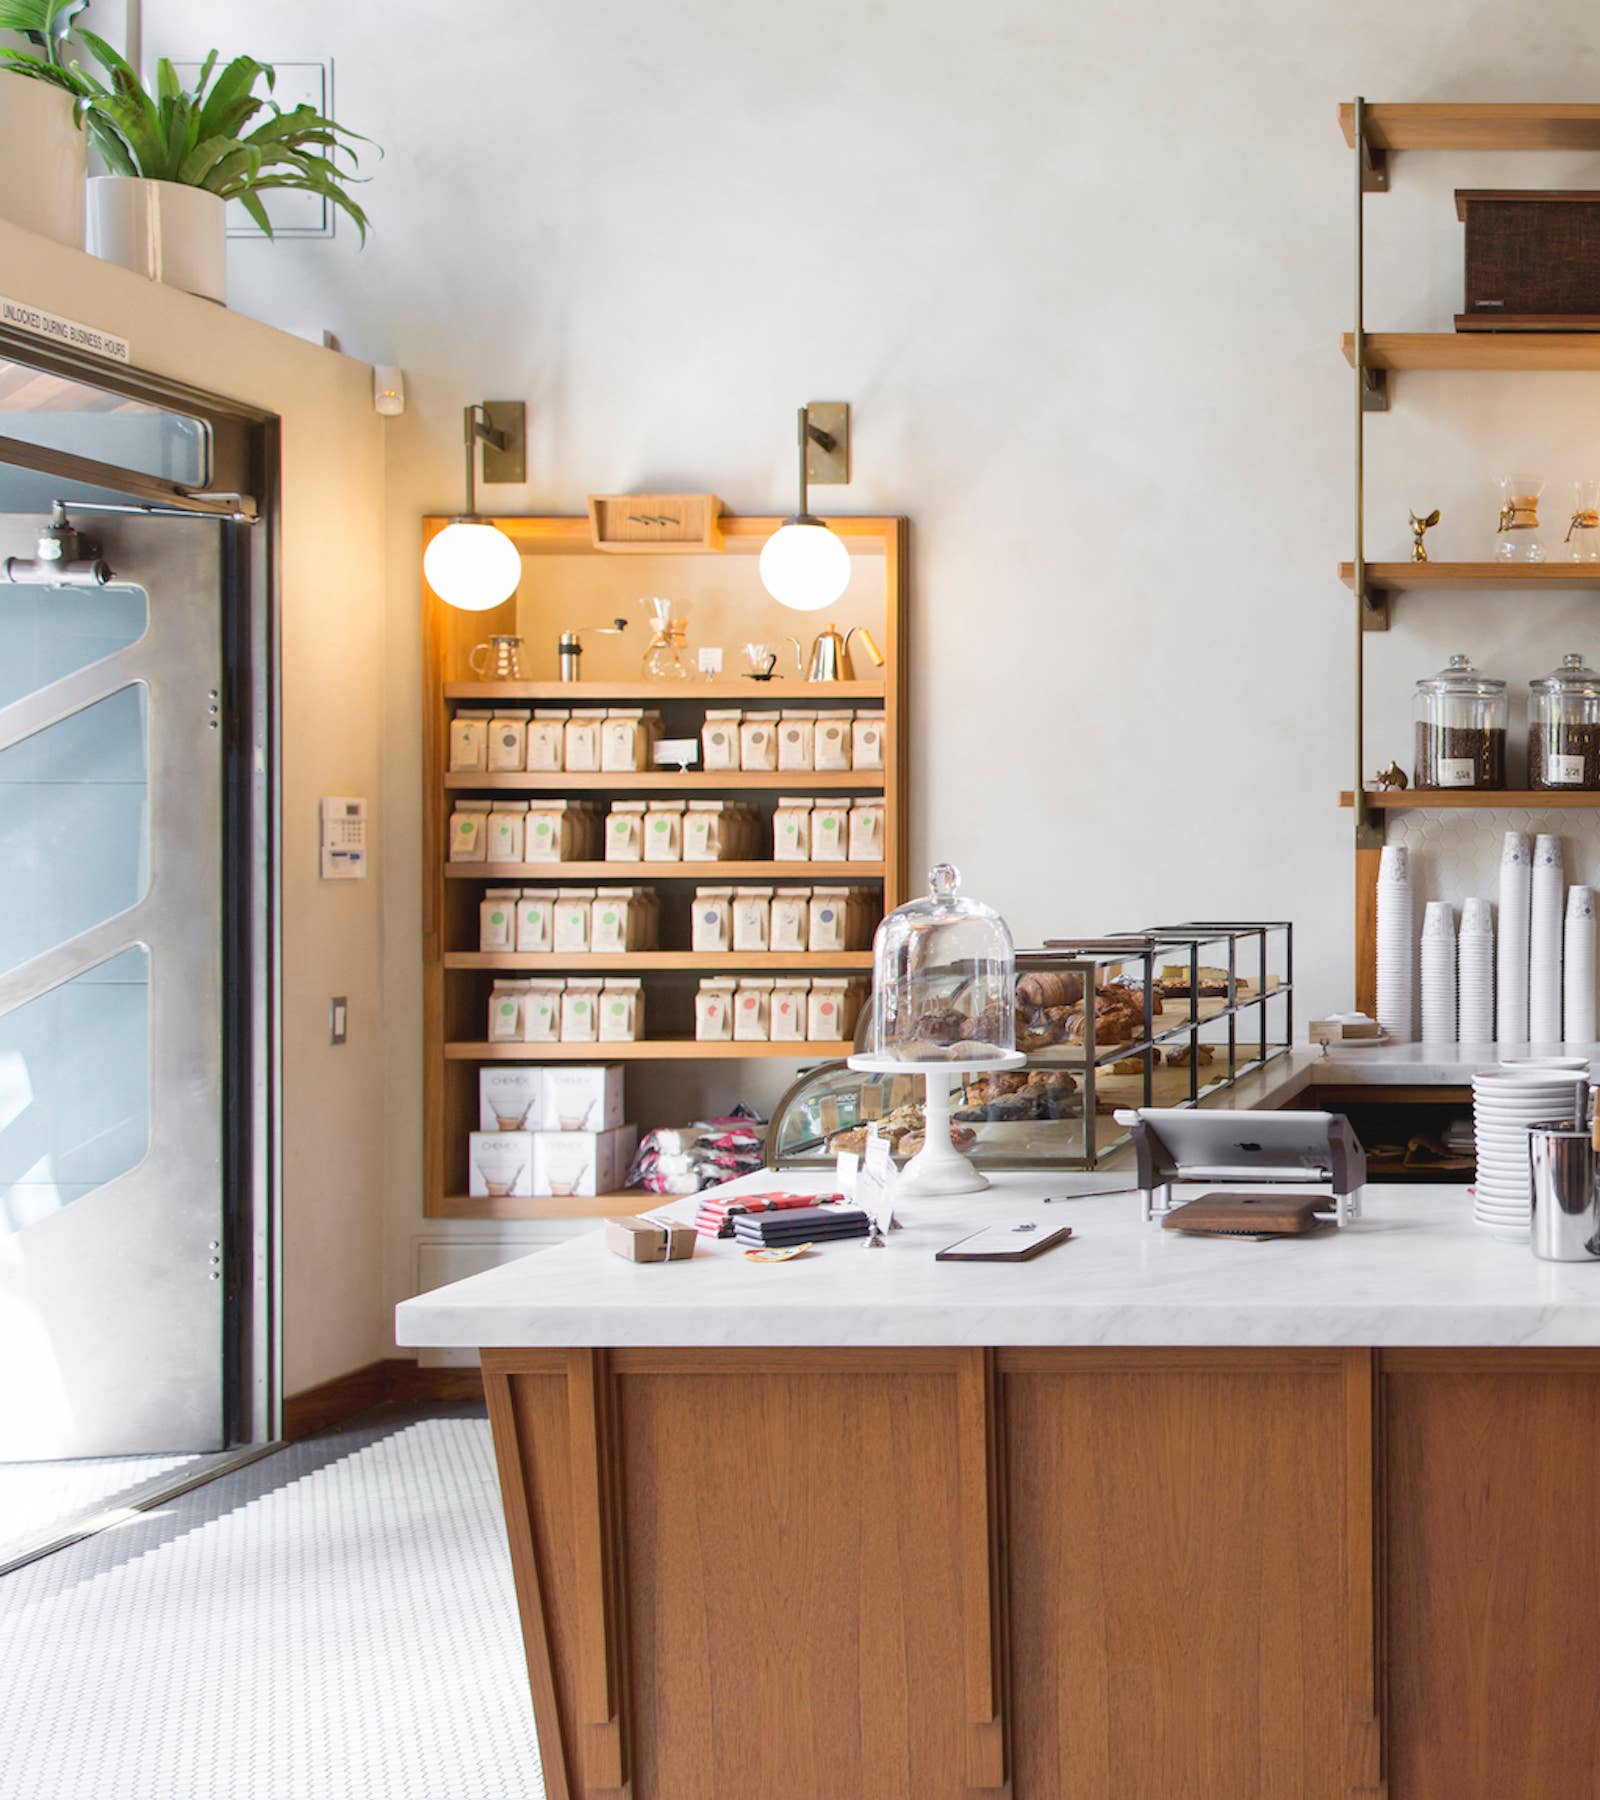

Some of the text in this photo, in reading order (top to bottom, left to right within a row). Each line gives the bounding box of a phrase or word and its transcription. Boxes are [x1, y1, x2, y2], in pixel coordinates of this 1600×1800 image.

[3, 304, 126, 358] UNLOCKED DURING BUSINESS HOURS
